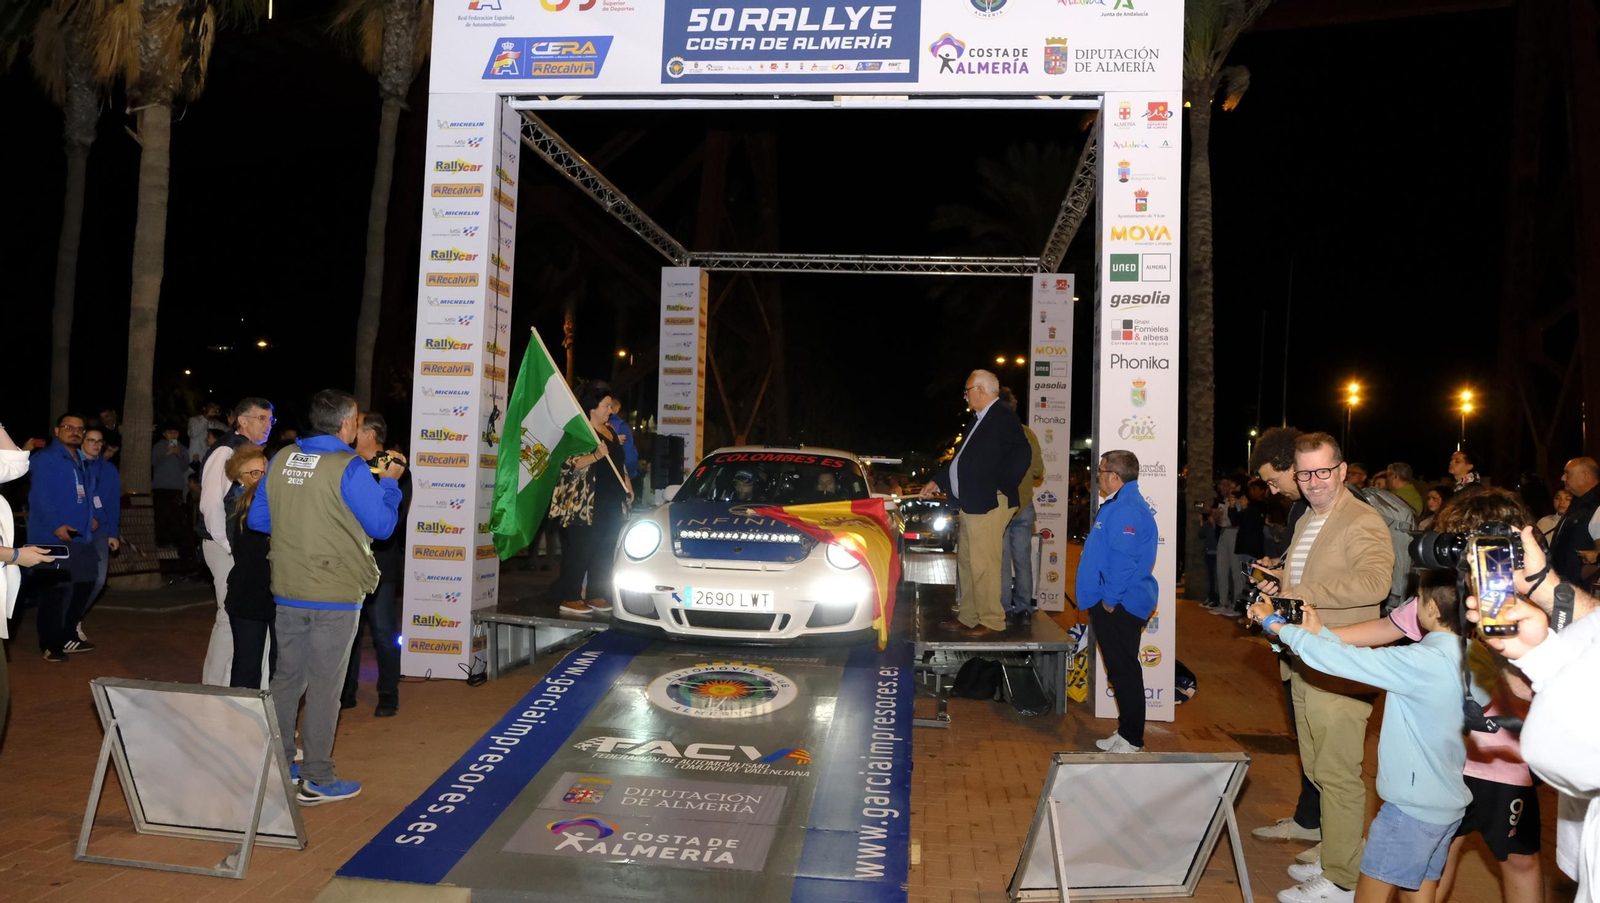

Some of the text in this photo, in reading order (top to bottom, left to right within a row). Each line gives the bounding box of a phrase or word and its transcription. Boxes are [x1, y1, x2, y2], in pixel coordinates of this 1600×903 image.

[686, 34, 892, 50] COSTA DE ALMERÍA
[968, 48, 1028, 58] COSTA DE
[1074, 46, 1160, 60] DIPUTACIÓN
[542, 63, 584, 74] Recalvi
[955, 59, 1030, 74] ALMERÍA
[1074, 60, 1157, 73] DE ALMERÍA
[436, 161, 483, 173] Rallycar
[440, 185, 474, 196] Recalvi
[1110, 225, 1172, 241] MOYA
[430, 250, 478, 262] Rallycar
[436, 274, 469, 286] Recalvi
[1110, 291, 1170, 308] gasolia
[426, 338, 473, 352] Rallycar
[430, 362, 464, 374] Recalvi
[1110, 354, 1169, 369] Phonika
[1034, 382, 1067, 391] gasolia
[420, 428, 468, 442] Rallycar
[426, 454, 460, 465] Recalvi
[282, 468, 314, 478] FOTO/TV
[416, 521, 465, 535] Rallycar
[676, 518, 791, 529] INFINI
[422, 546, 456, 558] Recalvi
[696, 591, 769, 607] 2690 LWT
[412, 614, 461, 628] Rallycar
[418, 640, 451, 652] Recalvi
[395, 650, 604, 844] www.garciaimpresores.es
[674, 763, 810, 777] COMUNITAT VALENCIANA
[678, 758, 771, 770] AUTOMOVILISMO
[855, 666, 903, 878] www.garciaimpresores.es
[624, 786, 763, 804] DIPUTACIÓN
[621, 796, 755, 814] DE ALMERÍA
[1510, 798, 1524, 826] 9
[622, 832, 740, 849] COSTA DE
[587, 842, 736, 864] ALMERÍA
